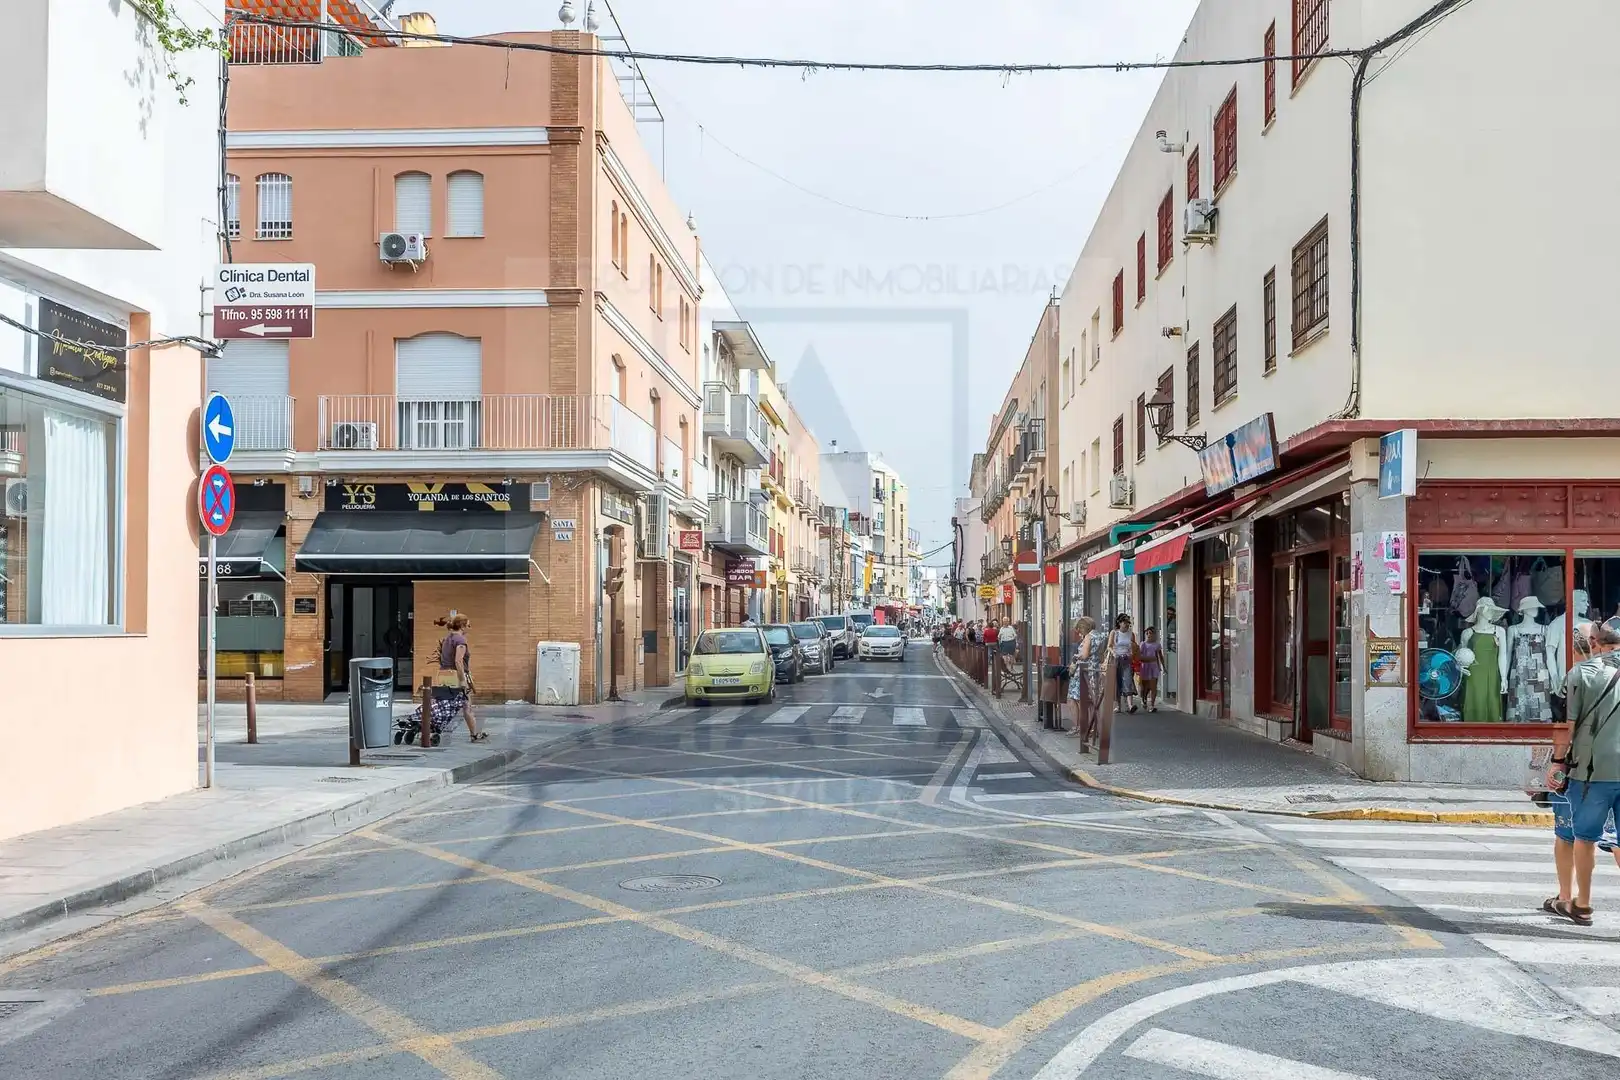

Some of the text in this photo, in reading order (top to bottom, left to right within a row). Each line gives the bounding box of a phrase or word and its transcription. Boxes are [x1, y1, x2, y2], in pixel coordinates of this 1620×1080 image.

[220, 269, 310, 282] Clínica Dental
[220, 308, 308, 320] Tlfno. 95 598 11 11
[343, 484, 376, 504] YS
[408, 492, 450, 501] YOLANDA
[474, 493, 510, 501] SANTOS
